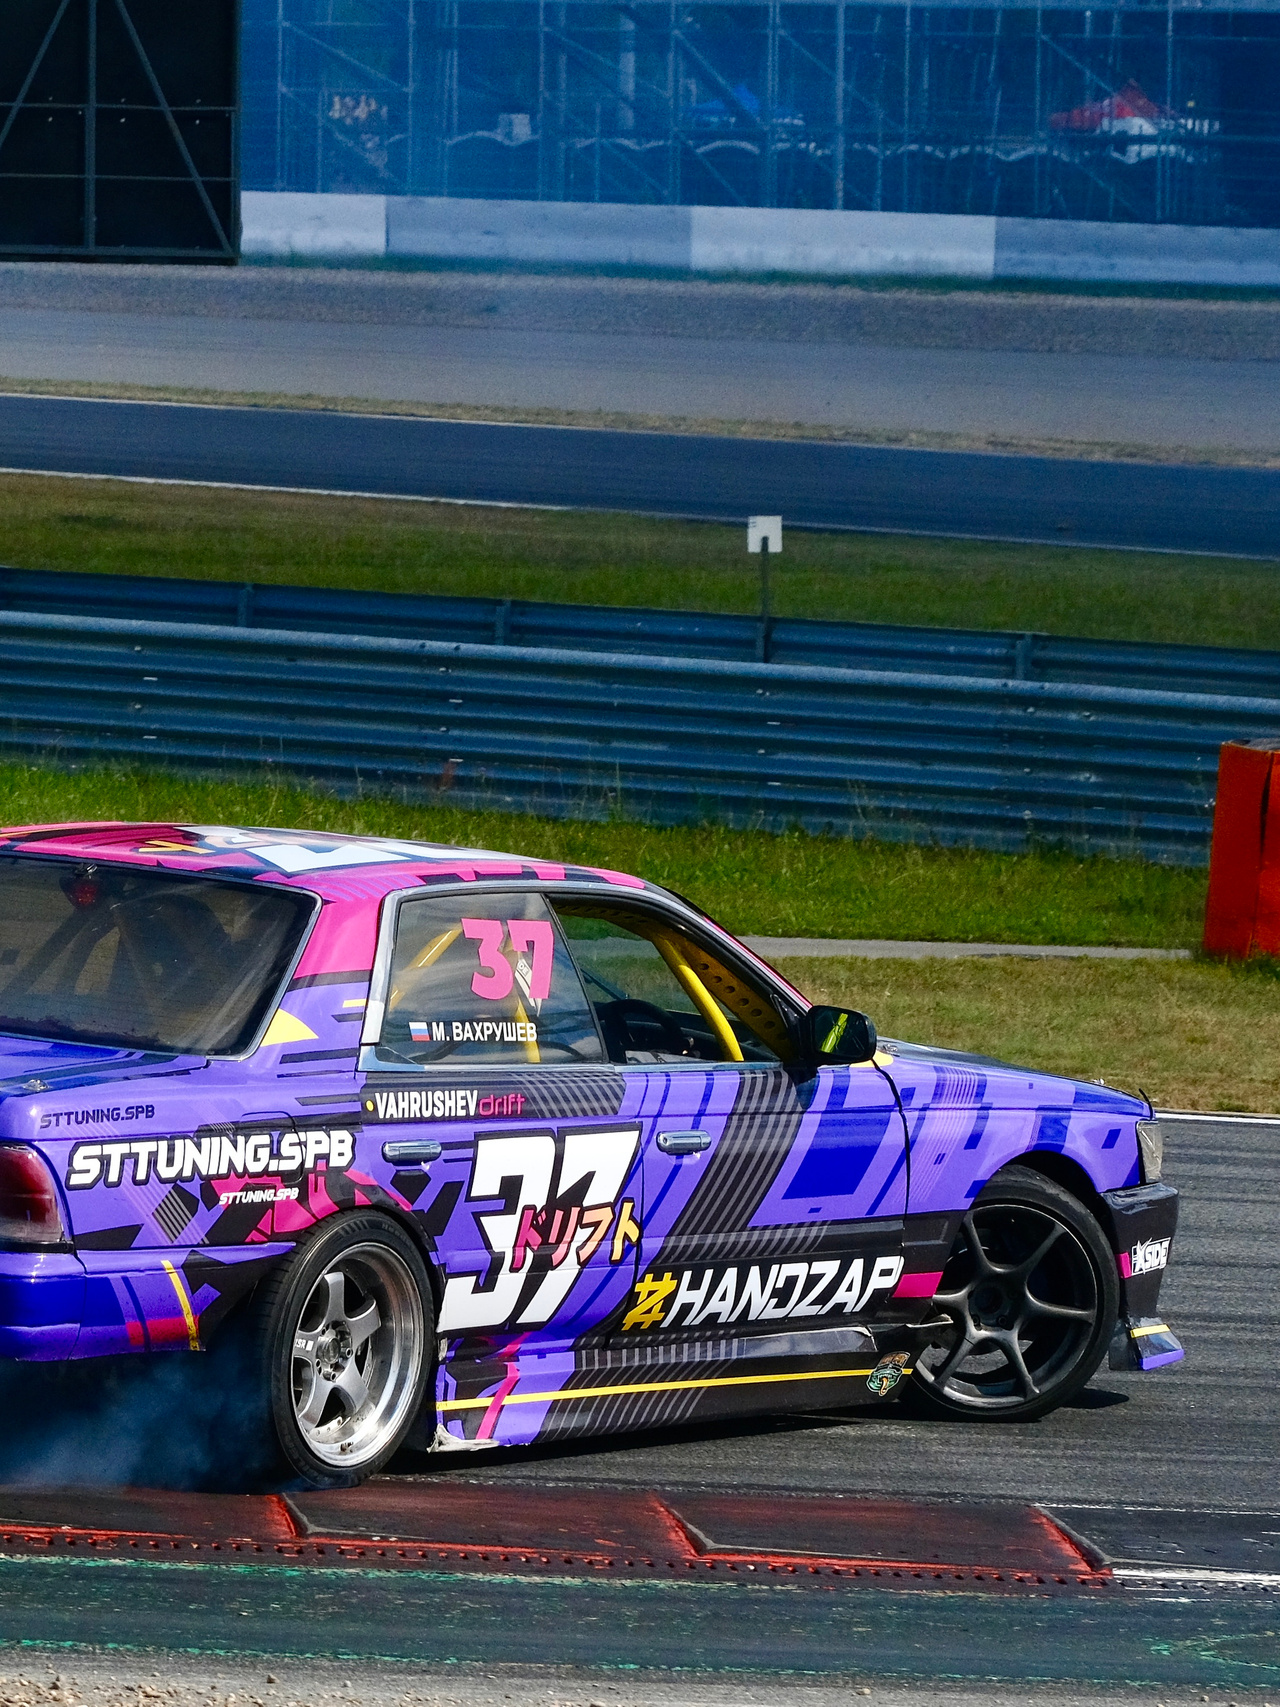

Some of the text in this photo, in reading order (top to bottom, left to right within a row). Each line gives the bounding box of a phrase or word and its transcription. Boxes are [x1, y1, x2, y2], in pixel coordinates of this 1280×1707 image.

[461, 918, 554, 1000] 37
[432, 1022, 538, 1042] М. ВАХРУШЕВ
[40, 1105, 155, 1129] STTUNING.SPB
[375, 1090, 526, 1118] VAHRUSHEV drift
[69, 1130, 355, 1186] STTUNING.SPB
[219, 1187, 300, 1205] STTUNING.SPB
[437, 1130, 640, 1332] 37
[510, 1200, 641, 1270] ドリフト
